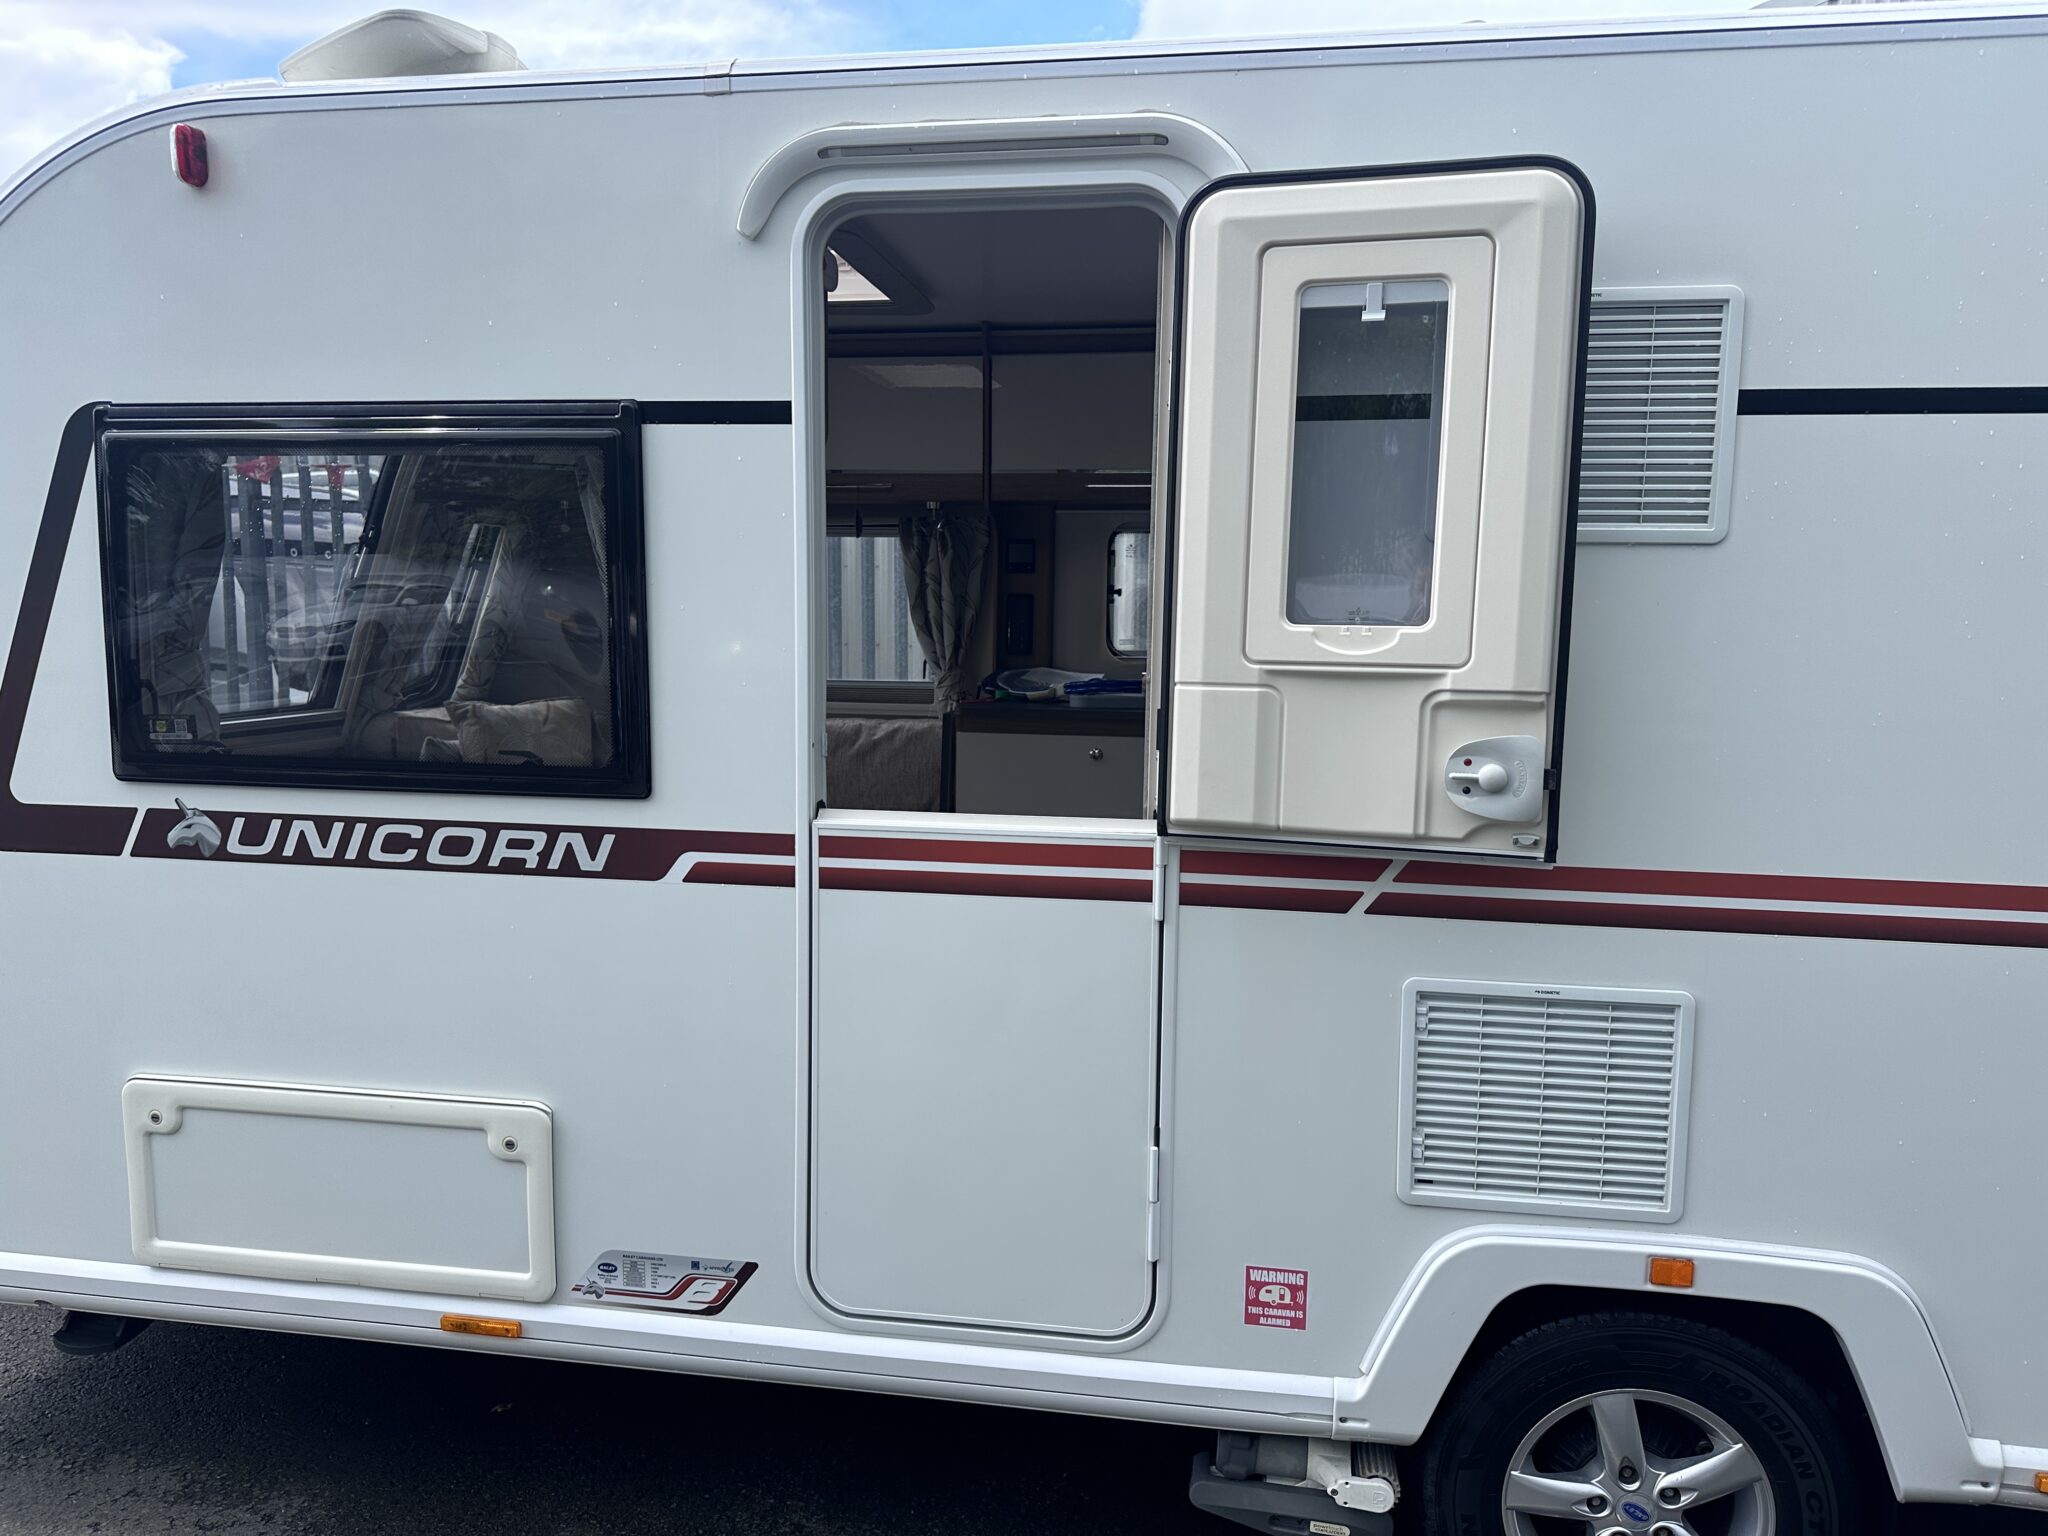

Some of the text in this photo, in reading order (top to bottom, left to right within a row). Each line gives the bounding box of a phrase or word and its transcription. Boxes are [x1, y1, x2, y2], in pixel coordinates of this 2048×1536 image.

[225, 816, 616, 872] UNICORN
[1249, 1269, 1304, 1286] WARNING
[1248, 1306, 1303, 1319] THIS CARAVAN IS
[1259, 1317, 1291, 1327] ALARMED
[1699, 1370, 1816, 1480] ROADIAN
